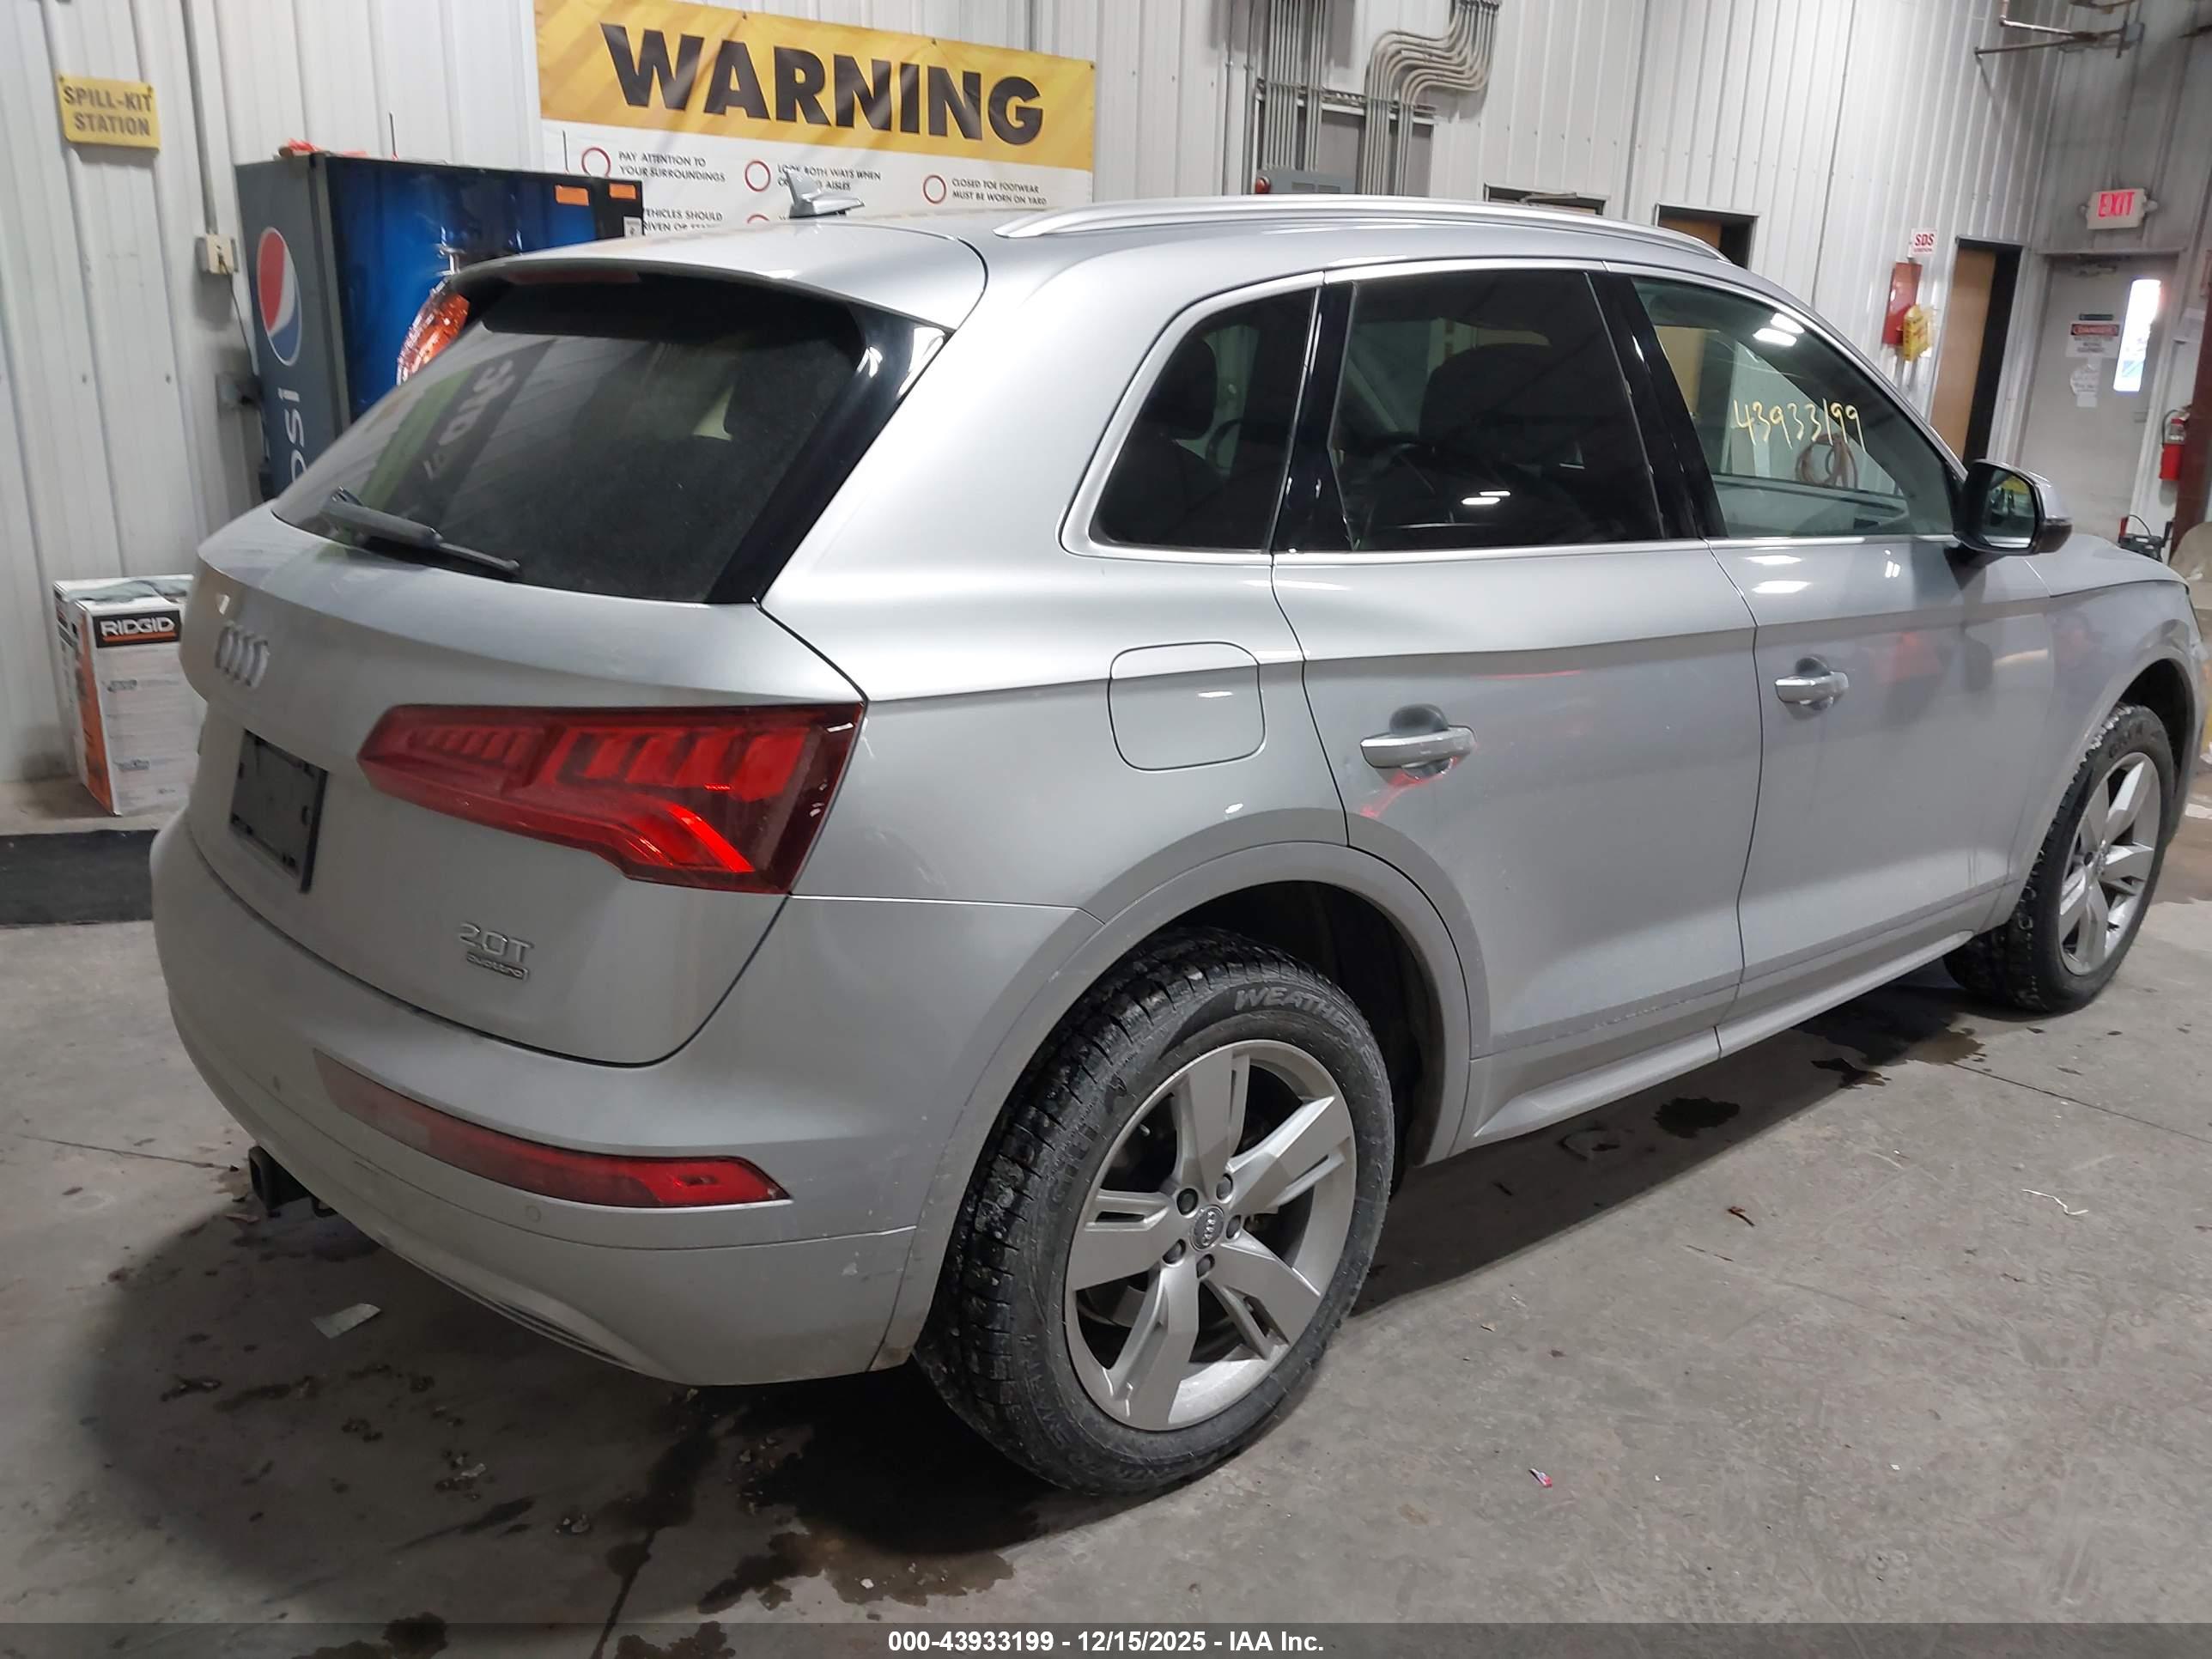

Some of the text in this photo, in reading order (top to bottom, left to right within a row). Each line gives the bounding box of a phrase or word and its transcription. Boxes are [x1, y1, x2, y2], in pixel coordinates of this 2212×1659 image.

[601, 22, 1043, 146] WARNING
[63, 84, 152, 112] SPILL-KIT
[74, 112, 151, 137] STATION
[618, 150, 706, 167] PAY ATTENTION TO
[619, 165, 726, 182] YOUR SURROUNDINGS
[830, 167, 854, 179] WAYS
[856, 170, 881, 181] WHEN
[951, 178, 981, 188] CLOSED
[999, 182, 1040, 194] FOOTWEAR
[952, 189, 974, 200] MUST
[975, 191, 985, 201] BE
[988, 192, 1012, 204] WORN
[1013, 196, 1027, 205] ON
[2099, 191, 2136, 217] EXIT
[684, 210, 723, 222] SHOULD
[1914, 233, 1935, 247] SDS
[1731, 397, 1868, 454] 43933199
[100, 617, 175, 637] RIDGID
